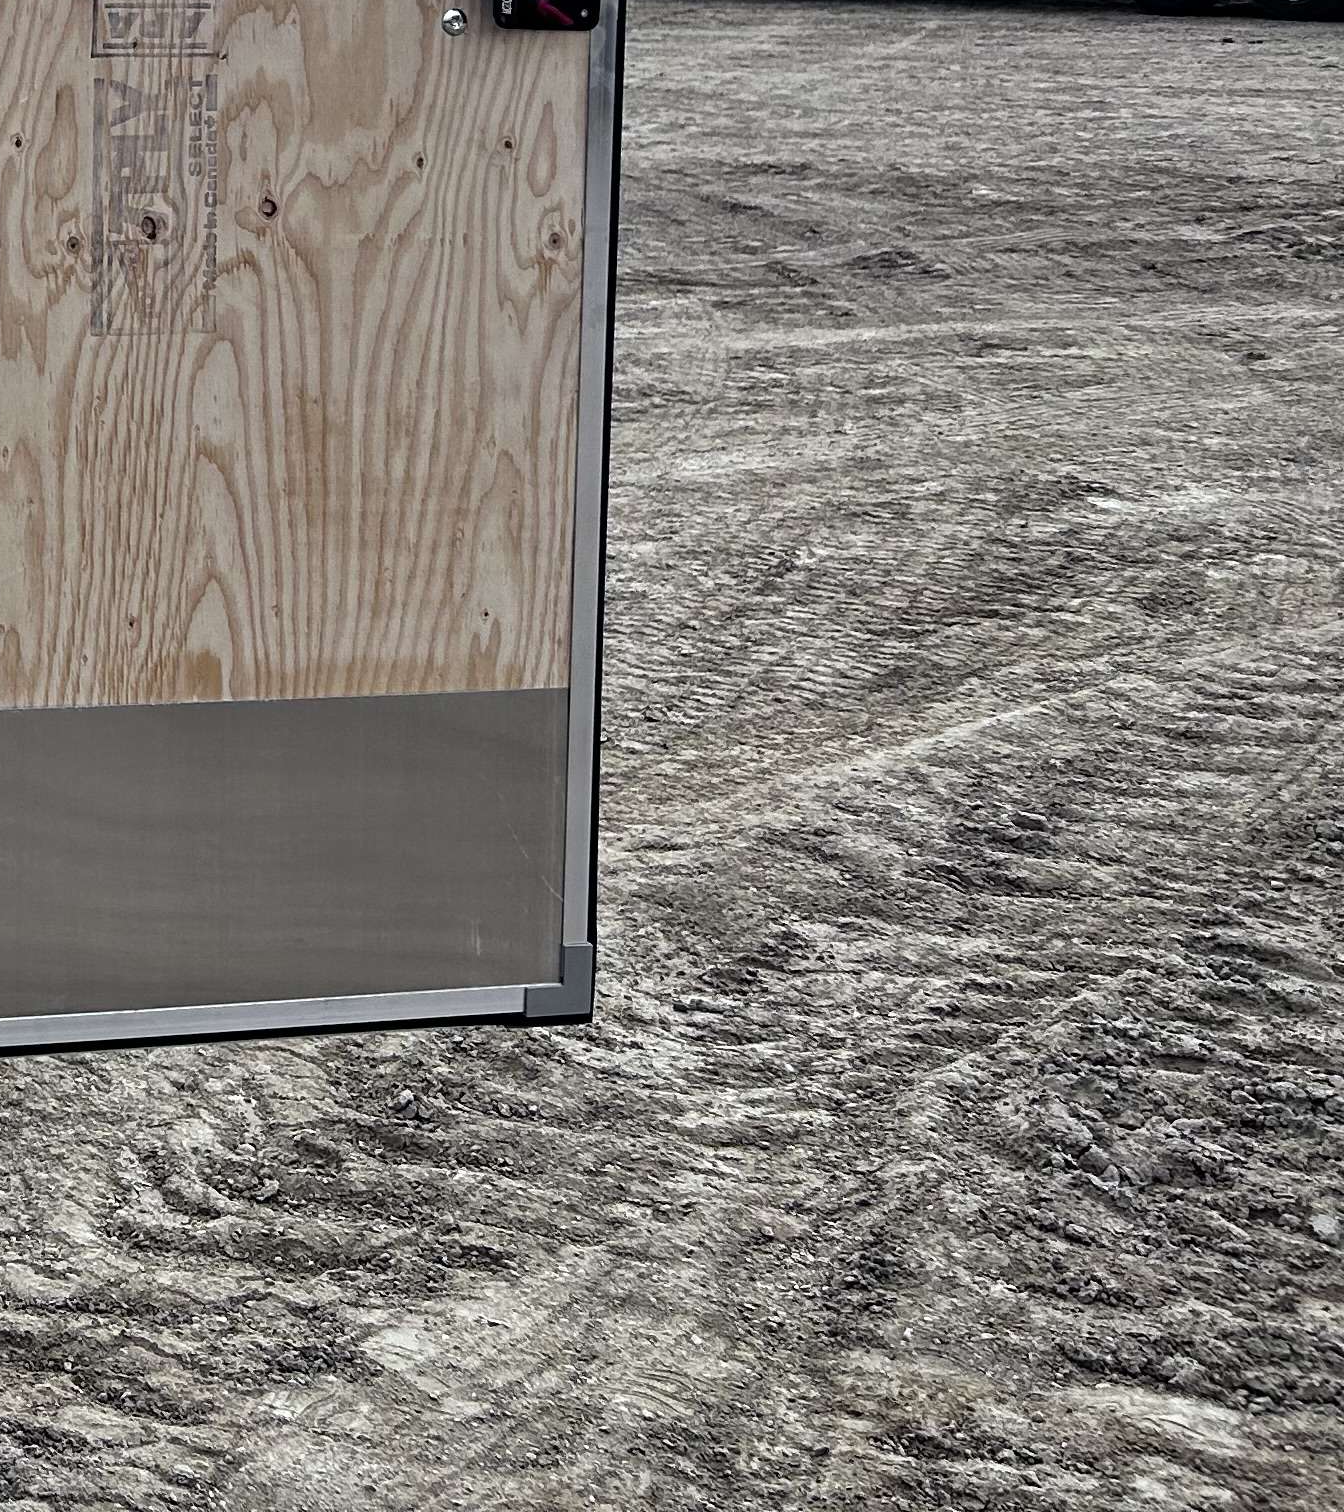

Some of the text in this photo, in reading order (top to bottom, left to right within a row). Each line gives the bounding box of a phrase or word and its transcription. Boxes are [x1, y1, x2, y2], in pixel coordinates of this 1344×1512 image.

[188, 77, 202, 177] SELECT
[204, 131, 218, 208] Canada
[203, 234, 218, 291] Made
